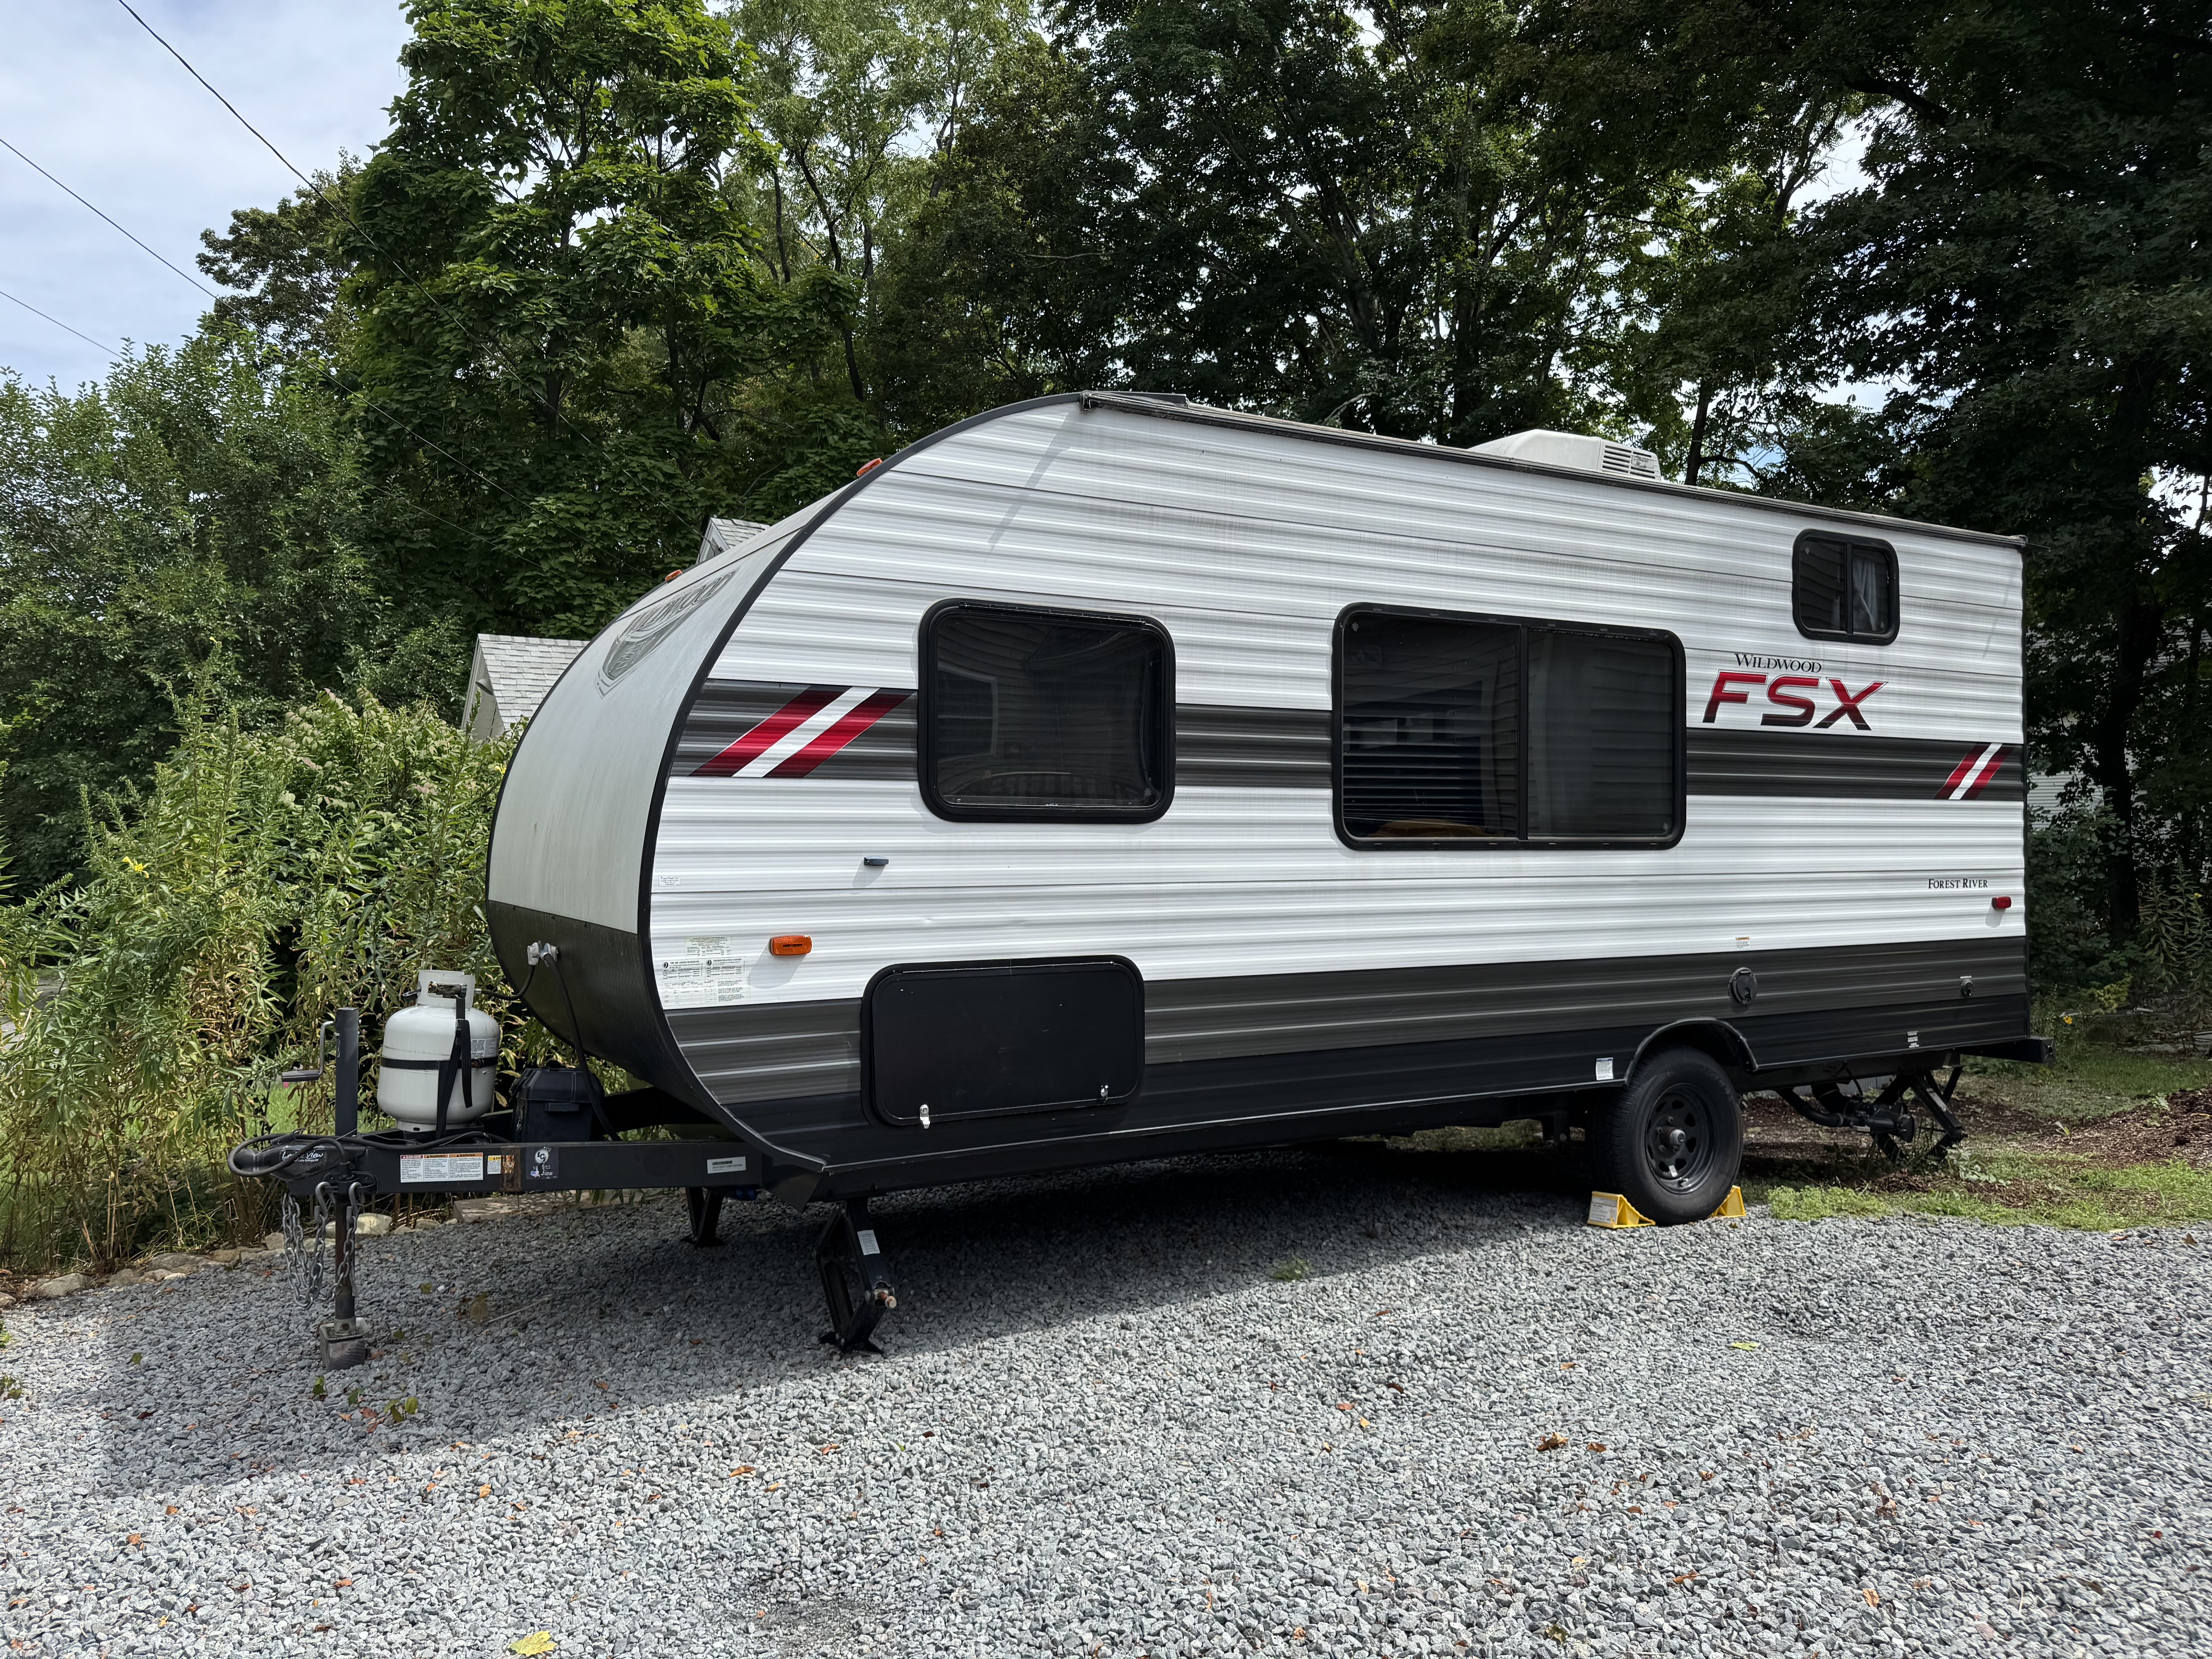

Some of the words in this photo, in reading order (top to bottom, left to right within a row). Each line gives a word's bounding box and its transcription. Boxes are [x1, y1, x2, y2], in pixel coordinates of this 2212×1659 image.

[1734, 653, 1822, 673] WILDWOOD
[1702, 669, 1889, 731] FSX
[1928, 878, 1961, 889] FOREST
[1962, 878, 1988, 888] RIVER
